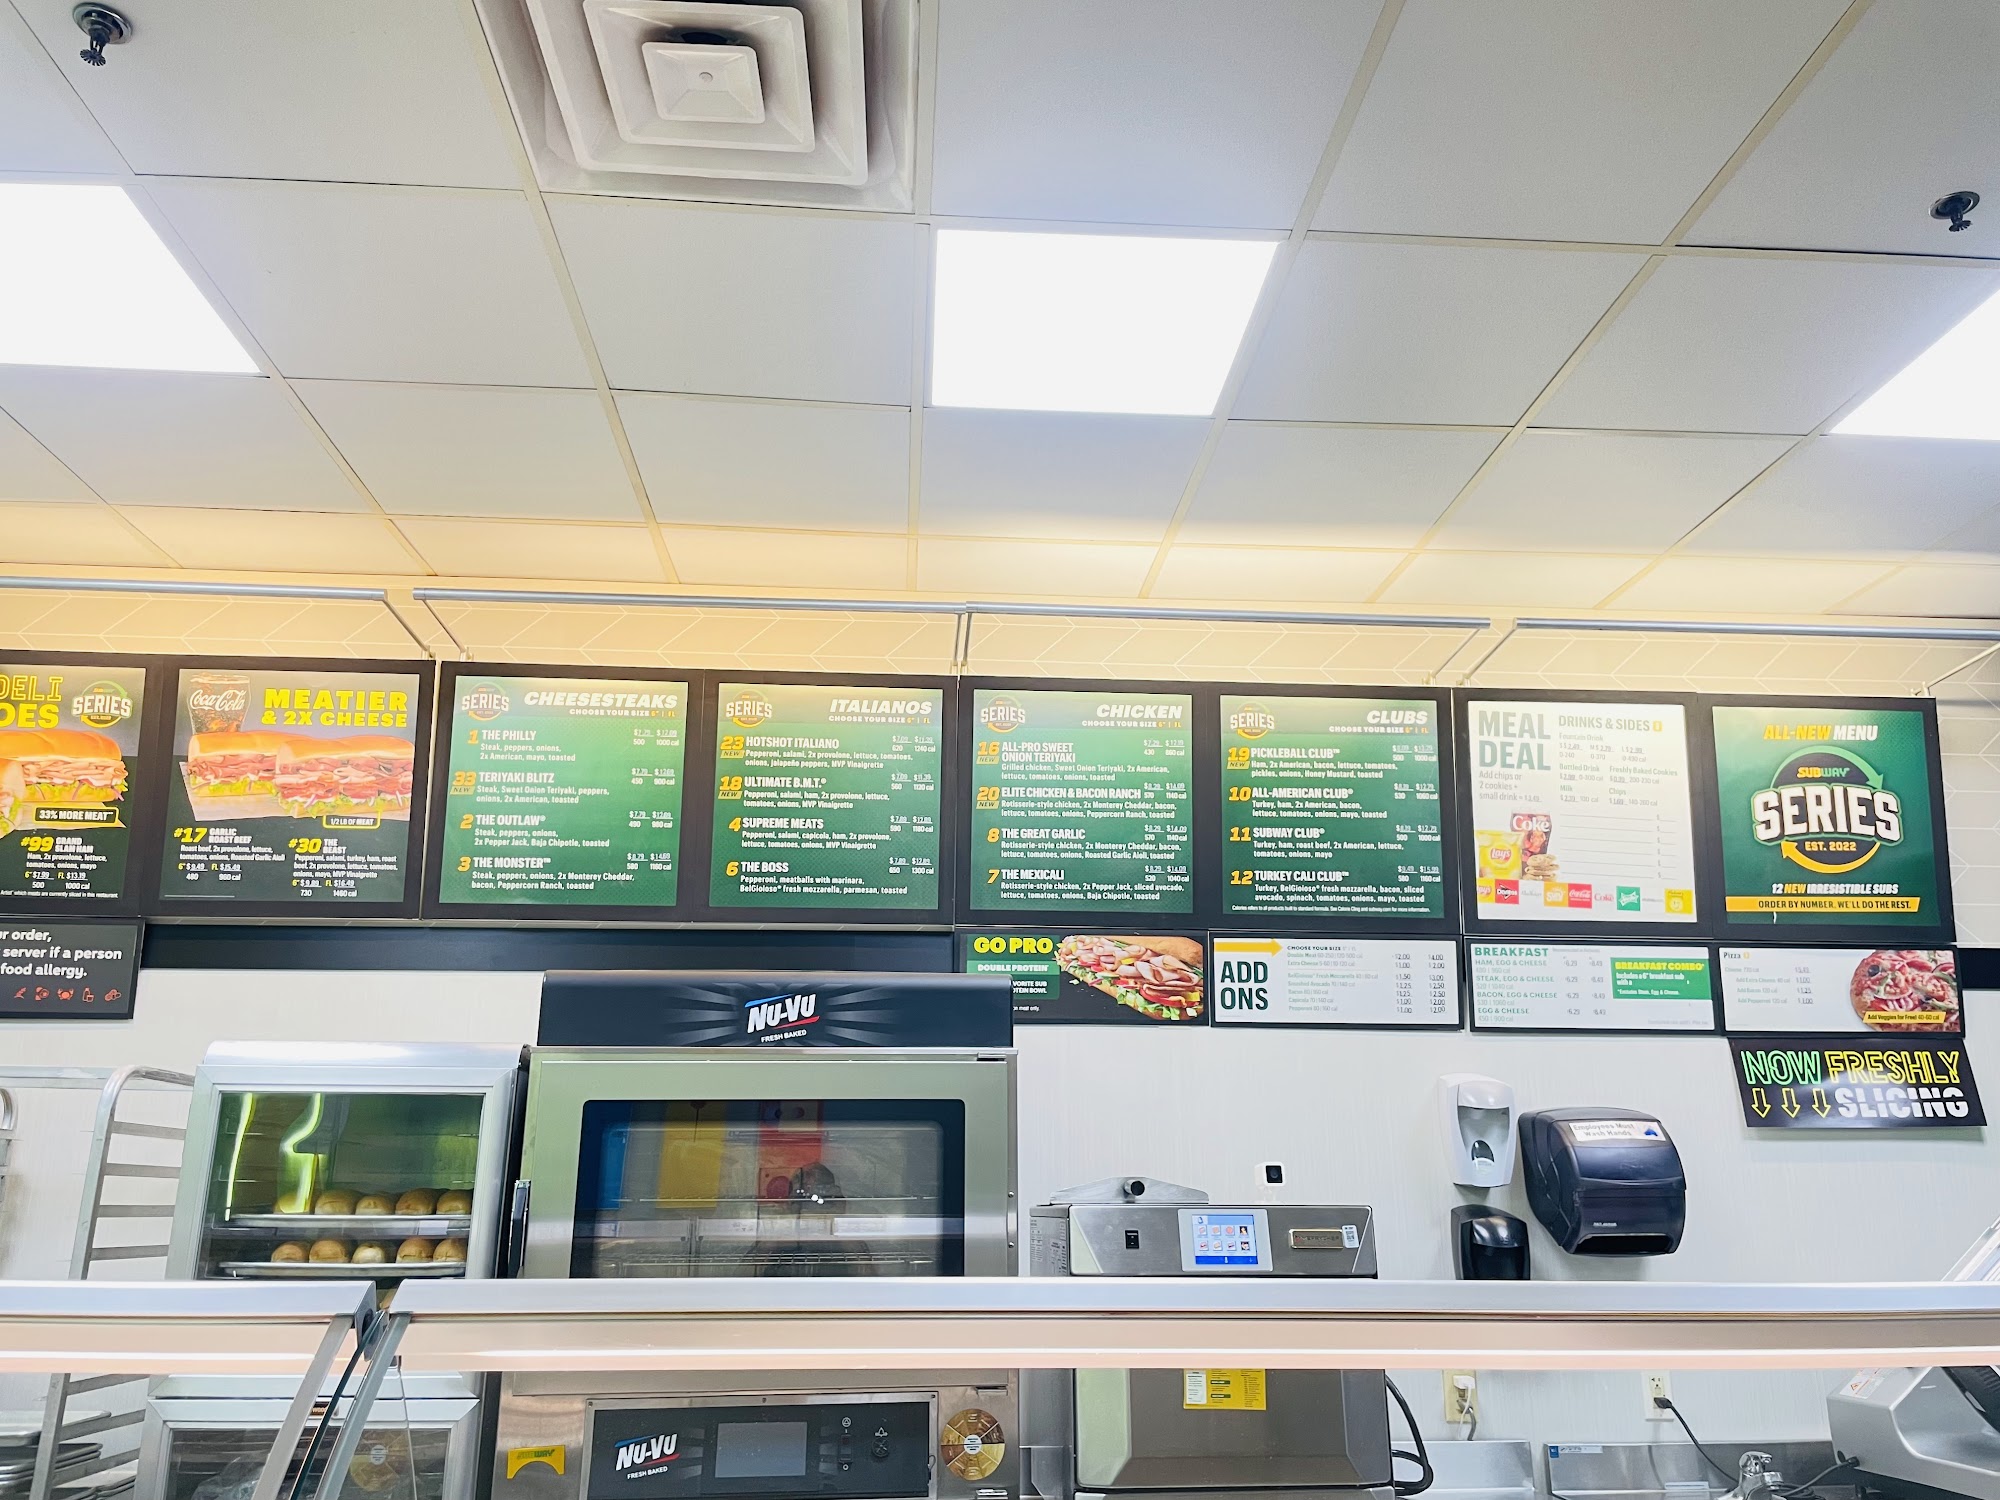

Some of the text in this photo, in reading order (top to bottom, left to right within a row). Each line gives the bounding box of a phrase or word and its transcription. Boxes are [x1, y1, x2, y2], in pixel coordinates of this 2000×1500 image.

[72, 695, 131, 718] SERIES
[190, 689, 246, 711] Coca-Cola
[264, 688, 408, 712] MEATIER
[461, 694, 510, 711] SERIES
[524, 692, 677, 708] CHEESESTEAKS
[830, 699, 932, 714] ITALIANOS
[726, 701, 772, 718] SERIES
[981, 707, 1025, 723] SERIES
[1097, 705, 1182, 718] CHICKEN
[261, 711, 407, 727] & 2X CHEESE
[1230, 712, 1275, 729] SERIES
[1367, 710, 1428, 724] CLUBS
[1559, 715, 1650, 731] DRINKS & SIDES
[1478, 710, 1551, 739] MEAL
[468, 730, 479, 743] 1
[482, 730, 536, 741] THE PHILLY
[1764, 725, 1878, 740] ALL-NEW MENU
[720, 736, 744, 749] 23
[746, 737, 839, 749] HOTSHOT ITALIANO
[978, 742, 1000, 755] 16
[1002, 742, 1073, 752] ALL-PRO SWEET
[1002, 753, 1075, 762] ONION TERIYAKI
[1228, 747, 1250, 761] 19
[1251, 748, 1307, 759] PICKLEBALL
[1479, 741, 1551, 771] DEAL
[452, 772, 476, 786] 33
[479, 772, 554, 783] TERIYAKI BLITZ
[1797, 767, 1850, 778] SUBWAY
[720, 776, 742, 790] 18
[745, 777, 792, 788] ULTIMATE
[977, 787, 1000, 800] 20
[1002, 788, 1141, 799] ELITE CHICKEN & BACON RANCH
[1229, 787, 1251, 801] 10
[1252, 788, 1322, 798] ALL-AMERICAN
[40, 810, 58, 819] 33%
[59, 811, 84, 820] MORE
[476, 815, 495, 825] THE
[1754, 786, 1901, 842] SERIES
[460, 814, 473, 829] 2
[729, 817, 741, 831] 4
[743, 818, 823, 829] SUPREME MEATS
[1512, 815, 1550, 832] Coke
[174, 828, 207, 843] #17
[209, 828, 237, 836] GARLIC
[987, 828, 999, 843] 8
[1001, 829, 1085, 839] THE GREAT GARLIC
[1230, 827, 1251, 841] 11
[1253, 828, 1293, 838] SUBWAY
[21, 837, 54, 852] #99
[234, 836, 251, 844] BEEF
[288, 838, 321, 853] #30
[1805, 842, 1857, 851] EST. 2022
[55, 845, 93, 853] SLAM HAM
[458, 857, 471, 871] 3
[474, 857, 493, 868] THE
[726, 861, 739, 876] 6
[741, 862, 789, 872] THE BOSS
[987, 870, 999, 884] 7
[1001, 870, 1064, 880] THE MEXICALI
[1231, 871, 1253, 885] 12
[1255, 871, 1292, 881] TURKEY
[1294, 871, 1317, 881] CALI
[1772, 883, 1898, 894] 12 NEW IRRESISTIBLE SUBS
[1800, 901, 1836, 909] NUMBER.
[1838, 901, 1860, 909] WE'LL
[1862, 901, 1873, 909] DO
[1875, 901, 1889, 909] THE
[1891, 901, 1911, 909] REST.
[12, 929, 52, 942] order,
[974, 937, 1053, 954] GO PRO
[1474, 947, 1549, 957] BREAKFAST
[3, 946, 122, 961] server if a person
[0, 963, 87, 979] food allergy.
[1220, 961, 1269, 983] ADD
[1220, 988, 1269, 1010] ONS
[761, 1030, 806, 1042] FRESH BAKED
[1741, 1050, 1821, 1085] NOW
[1824, 1051, 1960, 1084] FRESHLY
[1835, 1087, 1969, 1118] SLICING
[627, 1466, 668, 1479] FRESH BAKED
